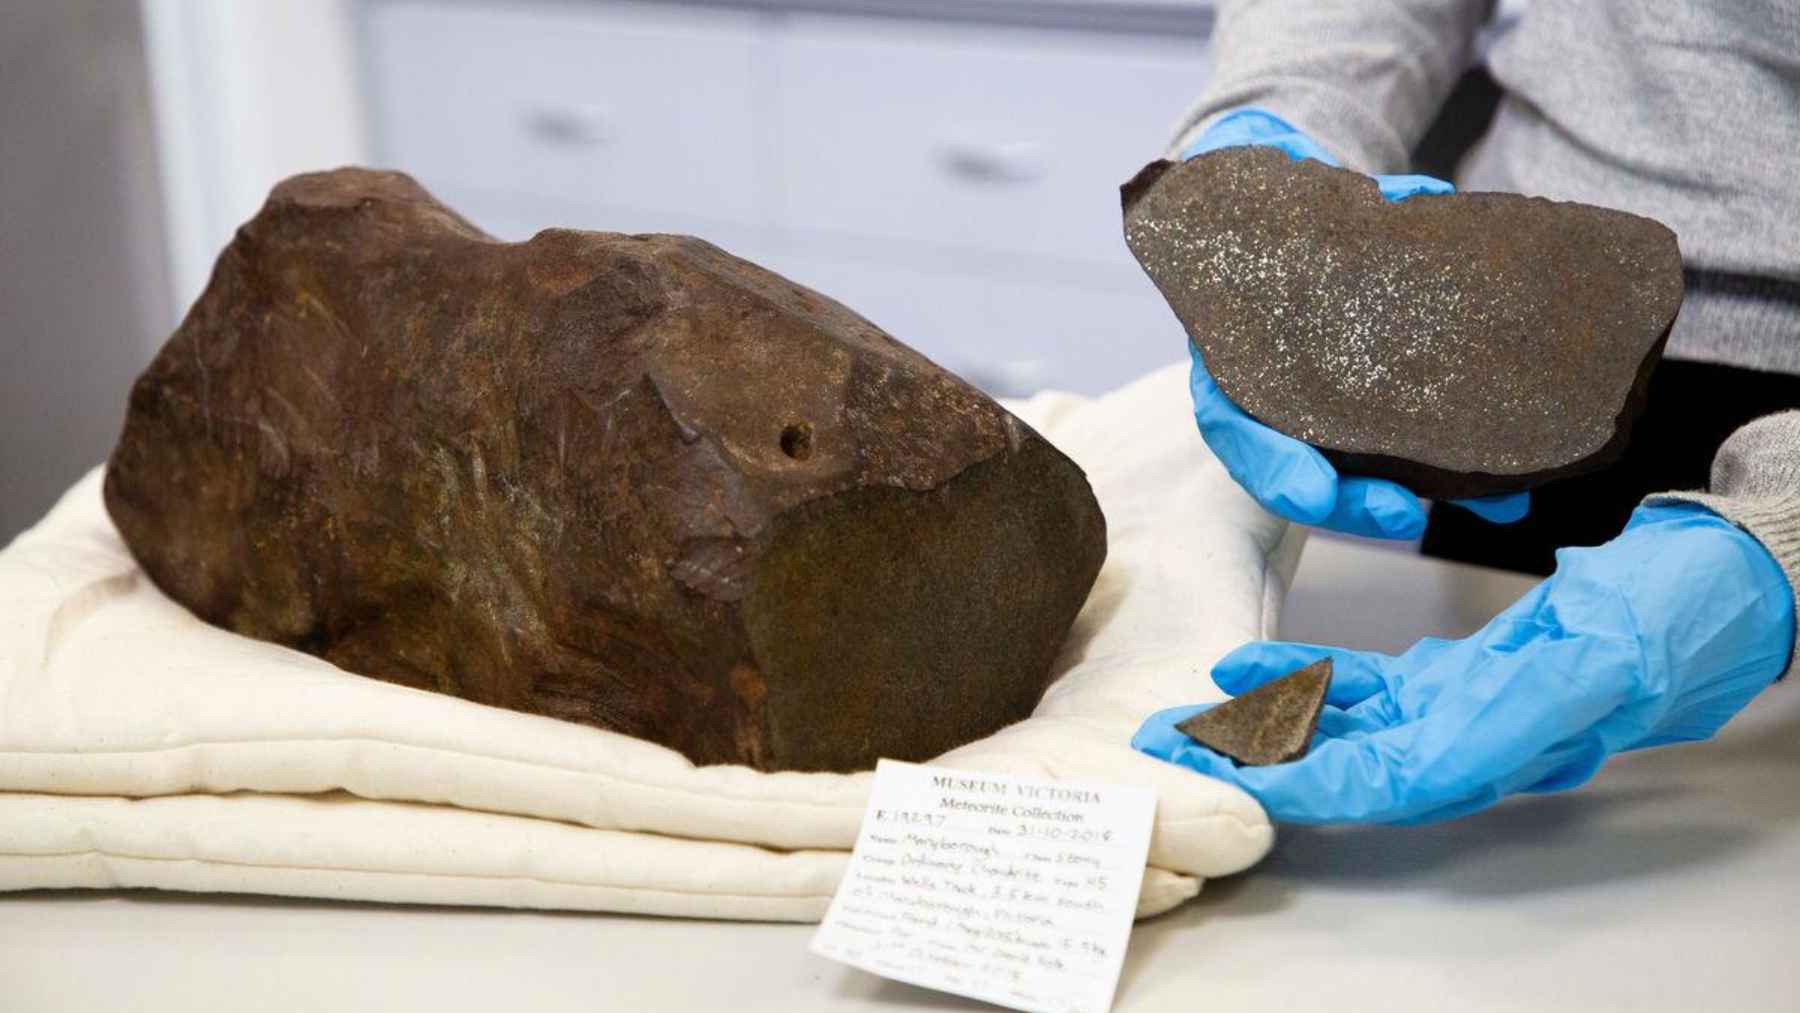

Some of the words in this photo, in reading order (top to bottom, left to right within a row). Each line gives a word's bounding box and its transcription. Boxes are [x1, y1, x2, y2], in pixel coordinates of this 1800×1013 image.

[932, 775, 1008, 796] MUSEUM
[1015, 783, 1103, 804] VICTORIA
[939, 797, 1009, 817] Meteorite
[1011, 804, 1085, 823] Collection
